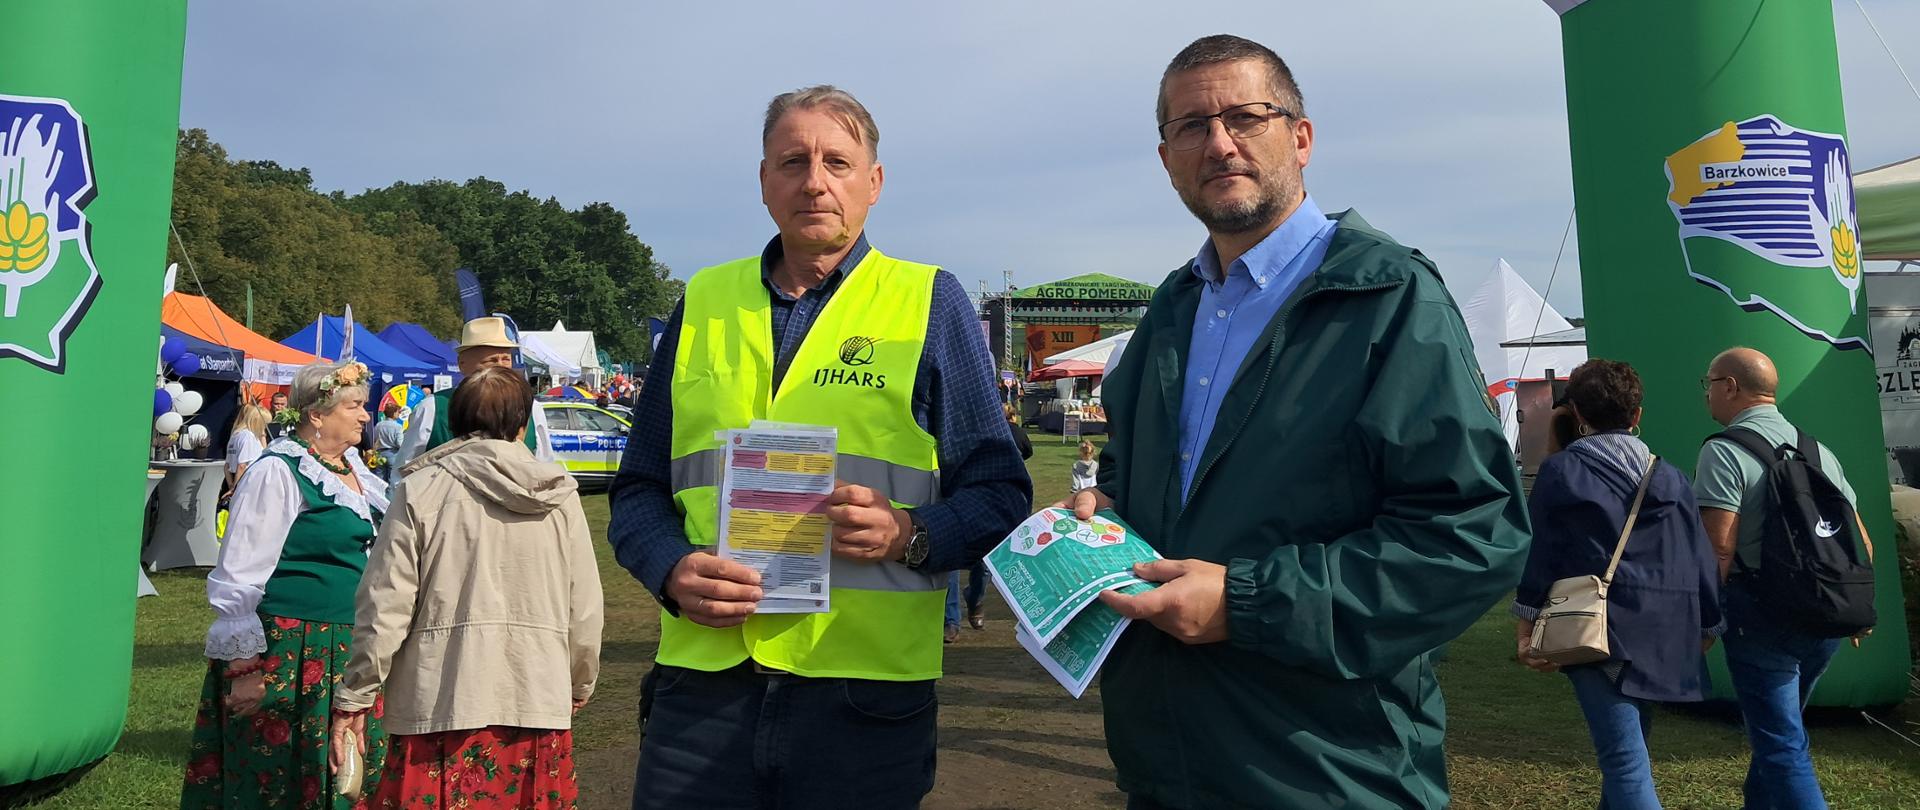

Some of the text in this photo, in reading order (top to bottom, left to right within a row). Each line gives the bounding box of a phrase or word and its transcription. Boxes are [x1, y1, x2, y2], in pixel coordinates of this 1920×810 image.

[1704, 164, 1787, 180] Barzkowice
[1036, 287, 1151, 299] AGRO POMERANI
[1052, 331, 1074, 343] XIII
[813, 368, 886, 389] IJHARS
